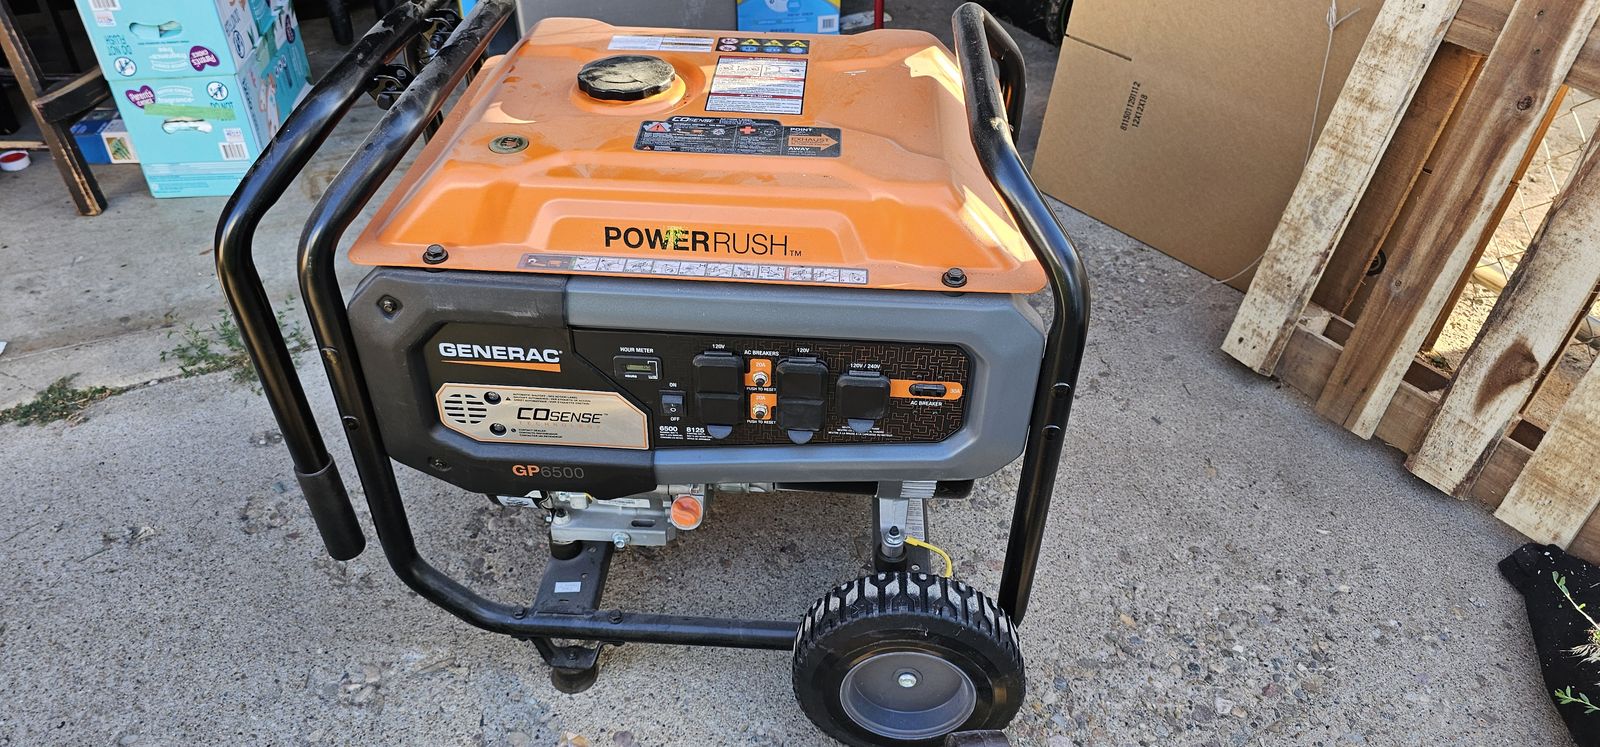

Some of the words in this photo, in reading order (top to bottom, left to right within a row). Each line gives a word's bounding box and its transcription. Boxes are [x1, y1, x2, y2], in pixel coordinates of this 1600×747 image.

[1132, 94, 1148, 128] 12X12X18
[439, 343, 560, 363] GENERAC
[512, 464, 585, 479] GP6500
